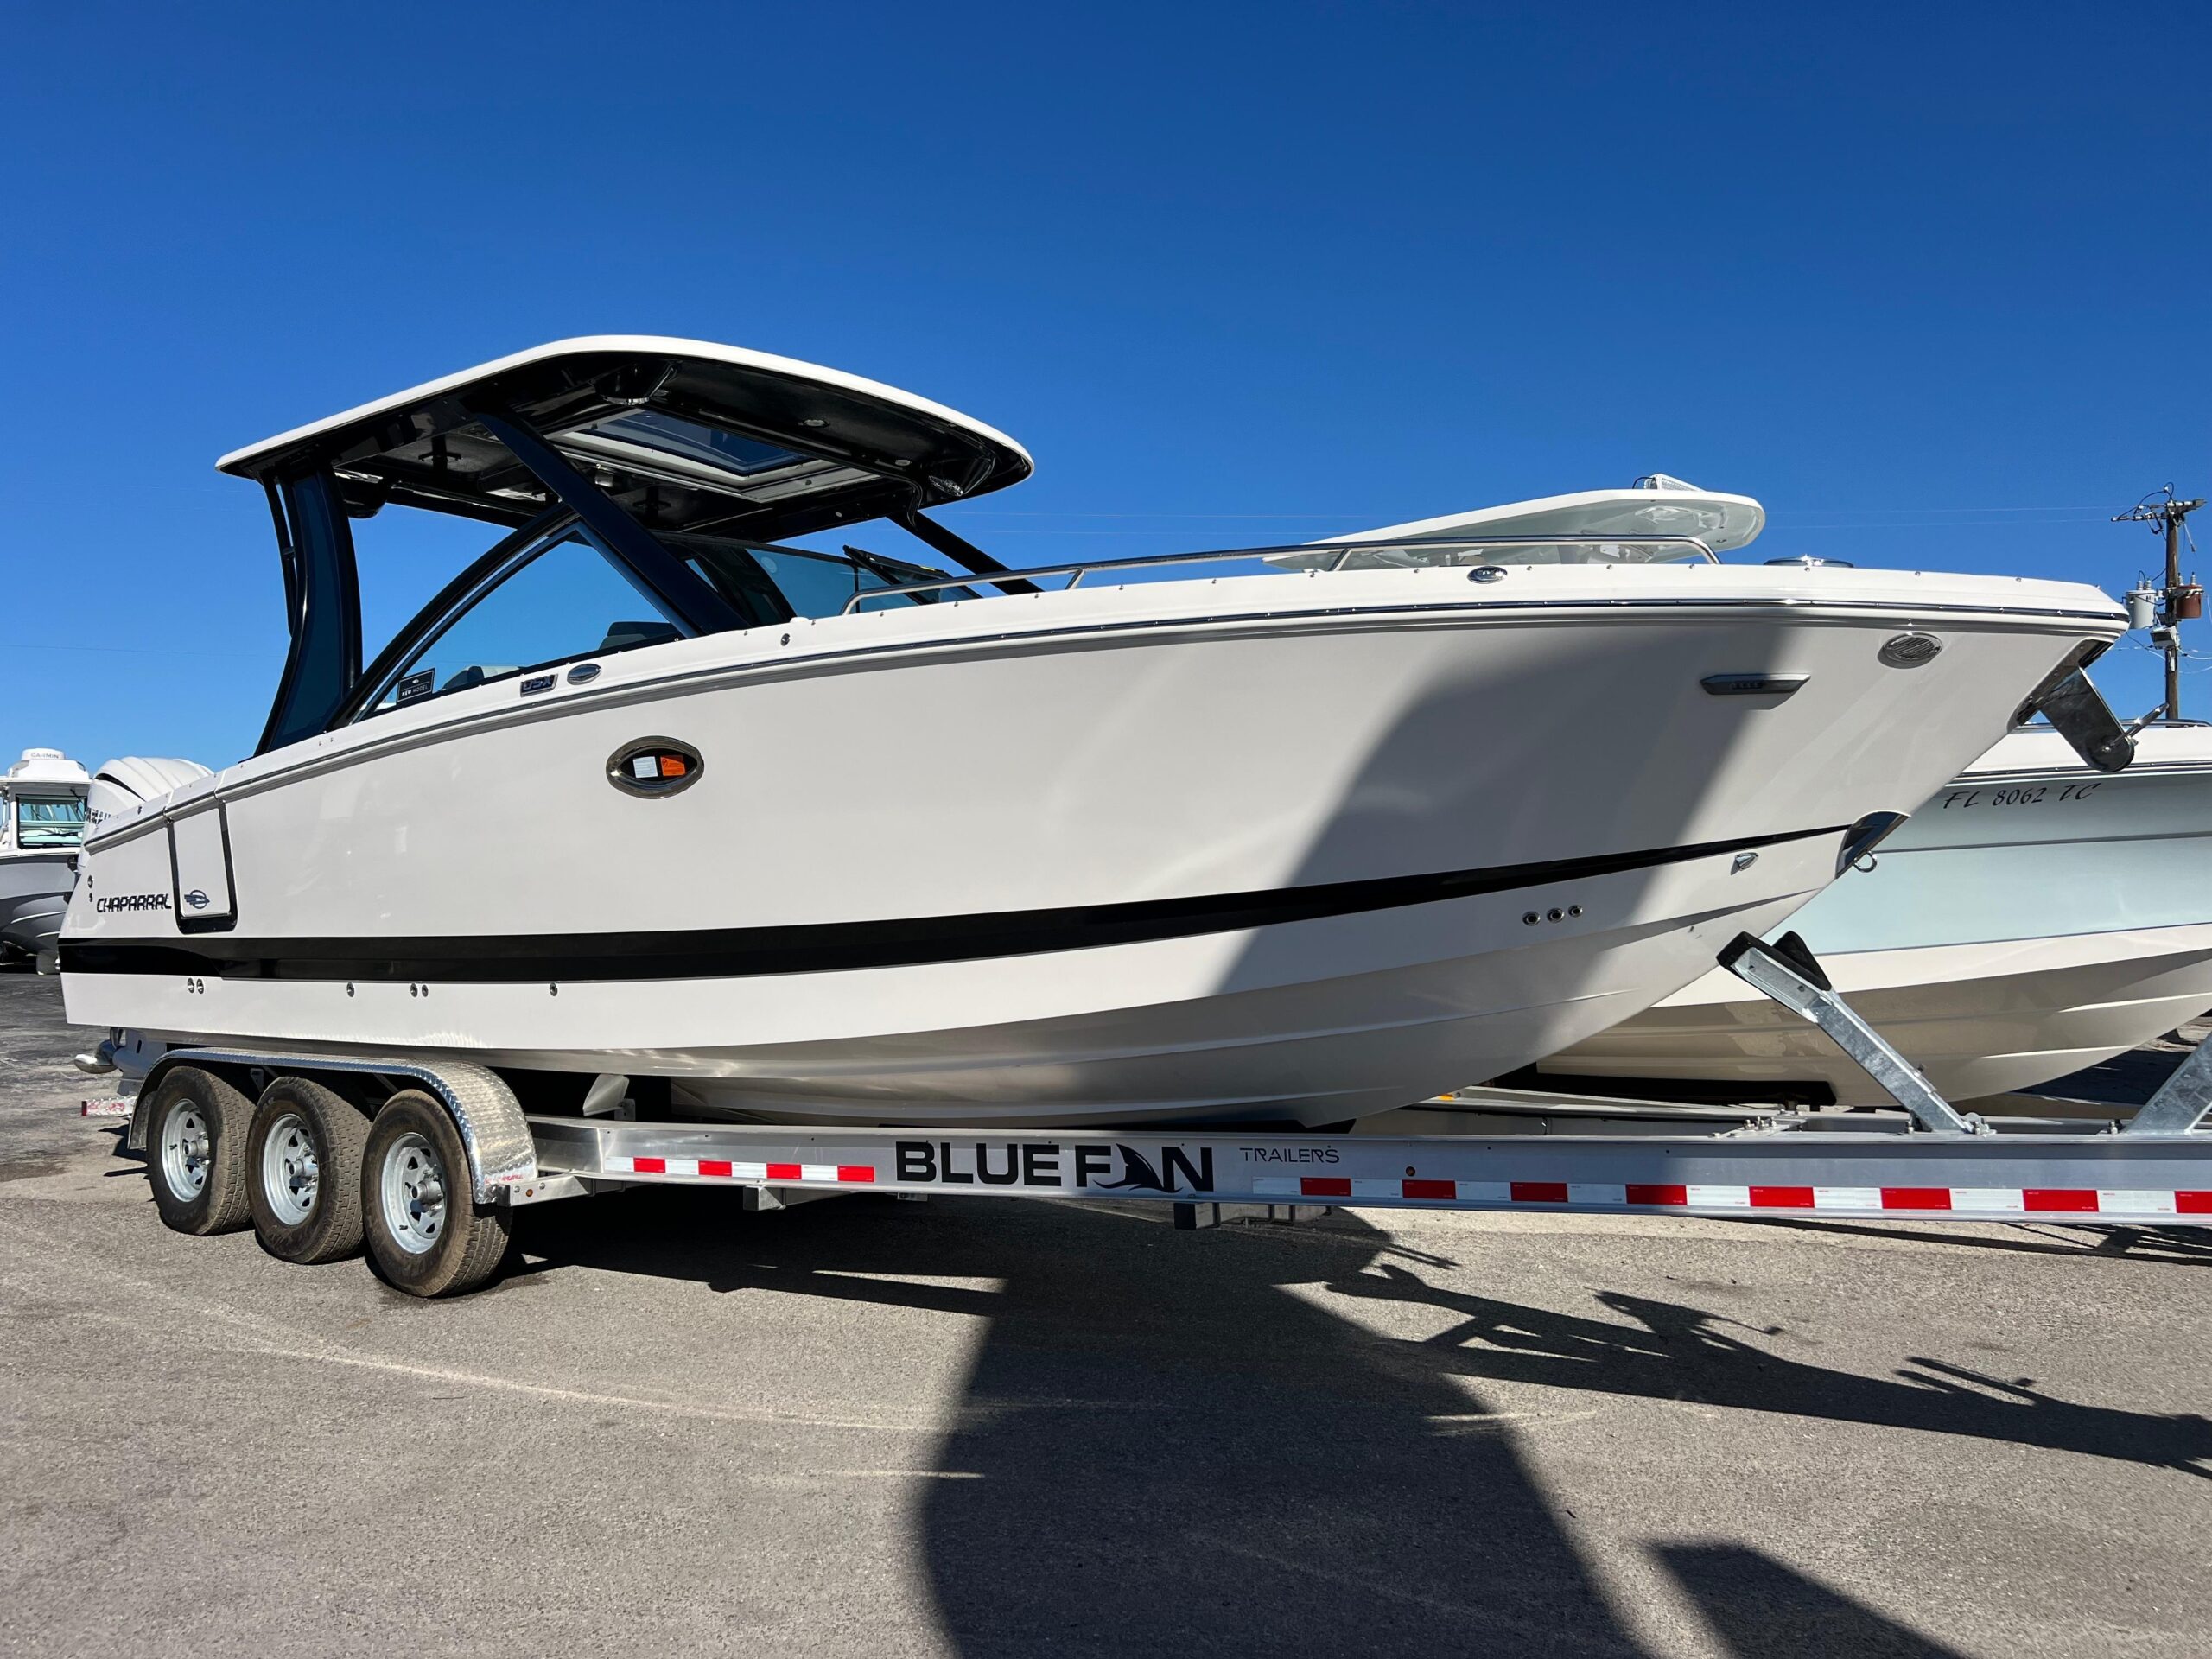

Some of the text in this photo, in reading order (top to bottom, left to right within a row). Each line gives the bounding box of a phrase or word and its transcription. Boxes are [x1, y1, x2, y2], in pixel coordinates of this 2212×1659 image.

[1943, 783, 2101, 809] FL 8062 TC
[97, 893, 172, 912] CHAPARRAL
[1239, 1147, 1339, 1163] TRAILERS
